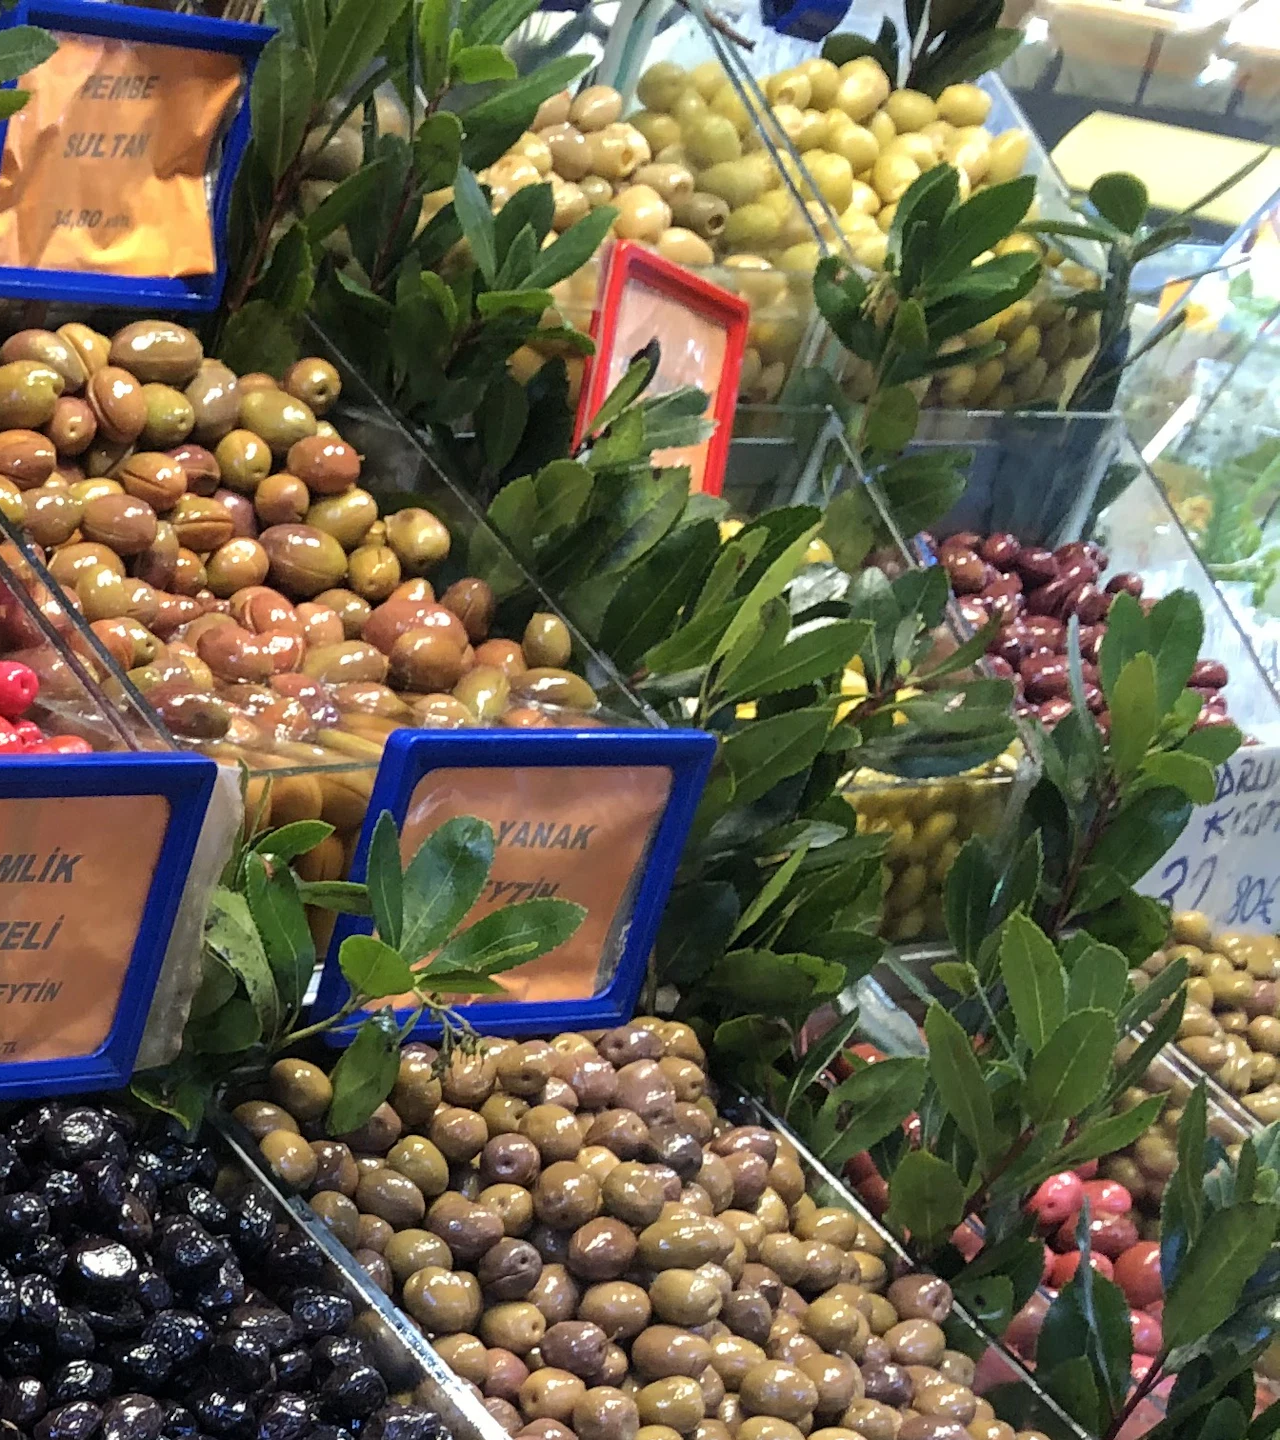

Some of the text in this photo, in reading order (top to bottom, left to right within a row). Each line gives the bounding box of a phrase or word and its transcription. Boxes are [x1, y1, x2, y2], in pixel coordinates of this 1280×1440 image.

[80, 75, 161, 101] PEMBE
[63, 132, 152, 160] SULTAN
[495, 820, 598, 851] YANAK
[487, 876, 560, 904] YTİN
